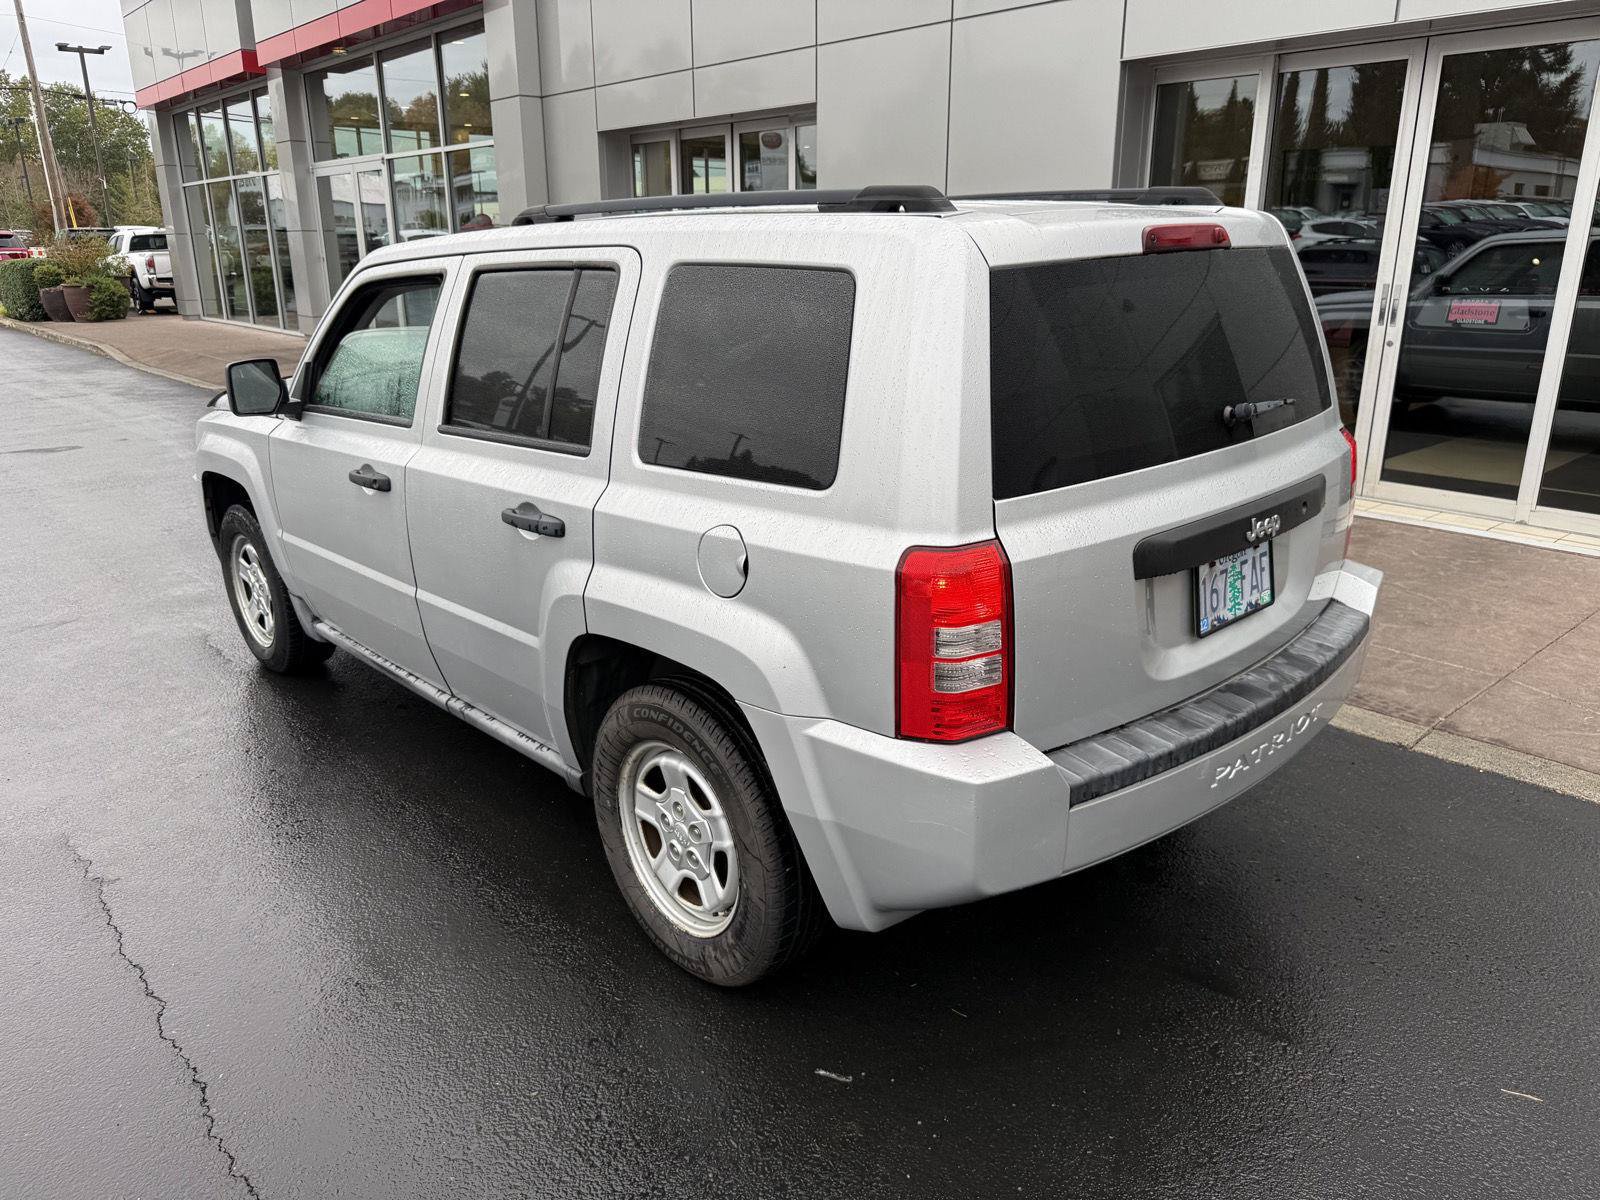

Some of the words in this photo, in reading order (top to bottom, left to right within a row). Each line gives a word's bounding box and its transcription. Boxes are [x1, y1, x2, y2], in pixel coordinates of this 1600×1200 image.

[1246, 514, 1281, 541] Jeep
[1200, 567, 1229, 619] 167
[633, 706, 722, 776] CONFIDENCE
[1211, 702, 1323, 788] PATRIOT
